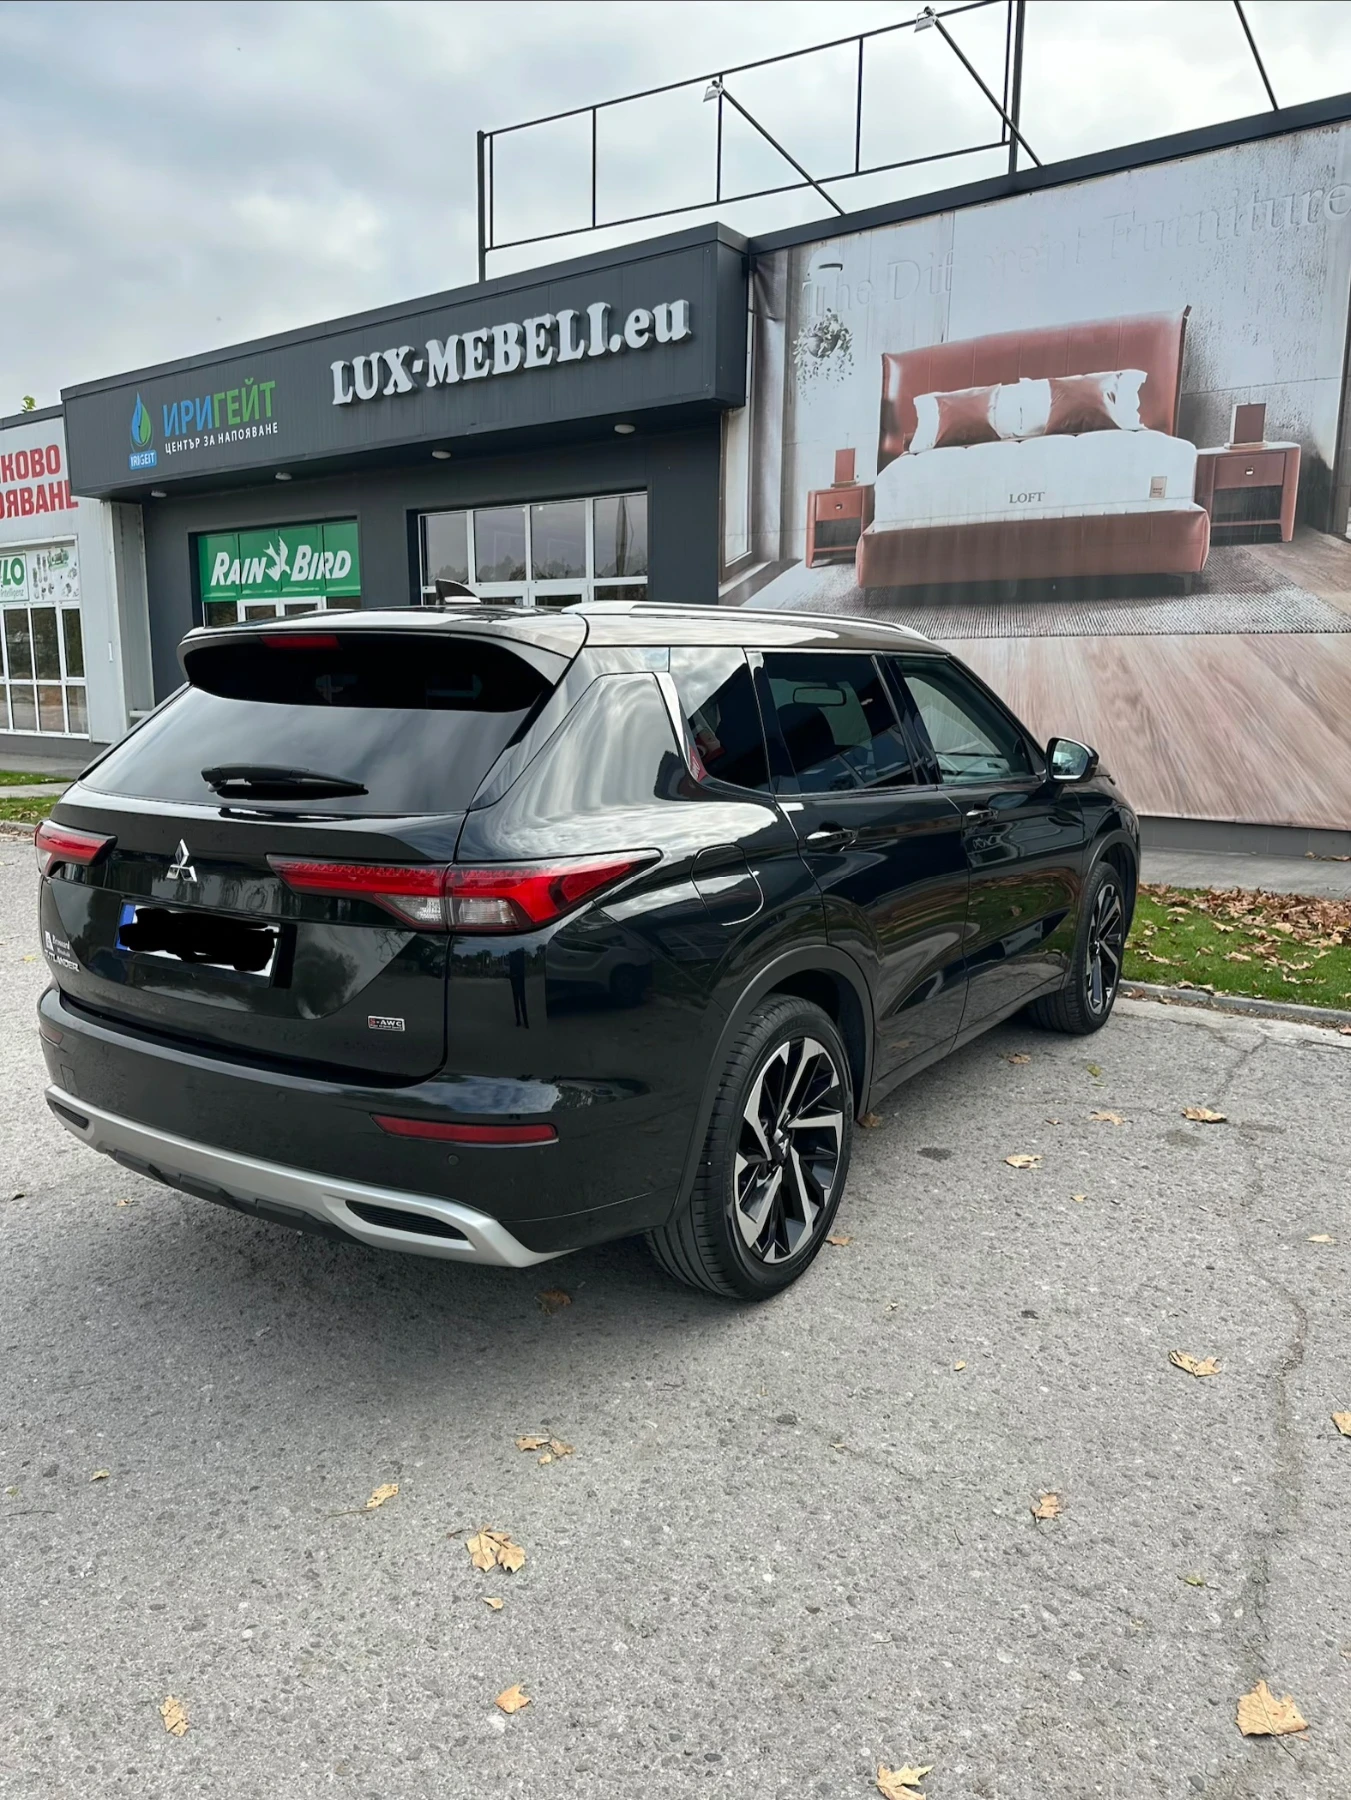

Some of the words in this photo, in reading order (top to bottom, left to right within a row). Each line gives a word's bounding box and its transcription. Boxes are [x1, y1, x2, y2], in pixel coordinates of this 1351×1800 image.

[330, 299, 692, 406] LUX-MEBELI.eu
[162, 377, 276, 438] ИРИГЕЙТ
[165, 438, 200, 455] ЦЕНТЪР
[203, 435, 216, 447] ЗА
[218, 421, 279, 445] НАПОЯВАНЕ
[0, 443, 62, 484] КОВО
[130, 451, 156, 468] IRIGEIT
[1008, 491, 1046, 505] LOFT
[0, 557, 25, 586] LO
[210, 551, 268, 587] RAIN
[290, 544, 352, 582] BIRD
